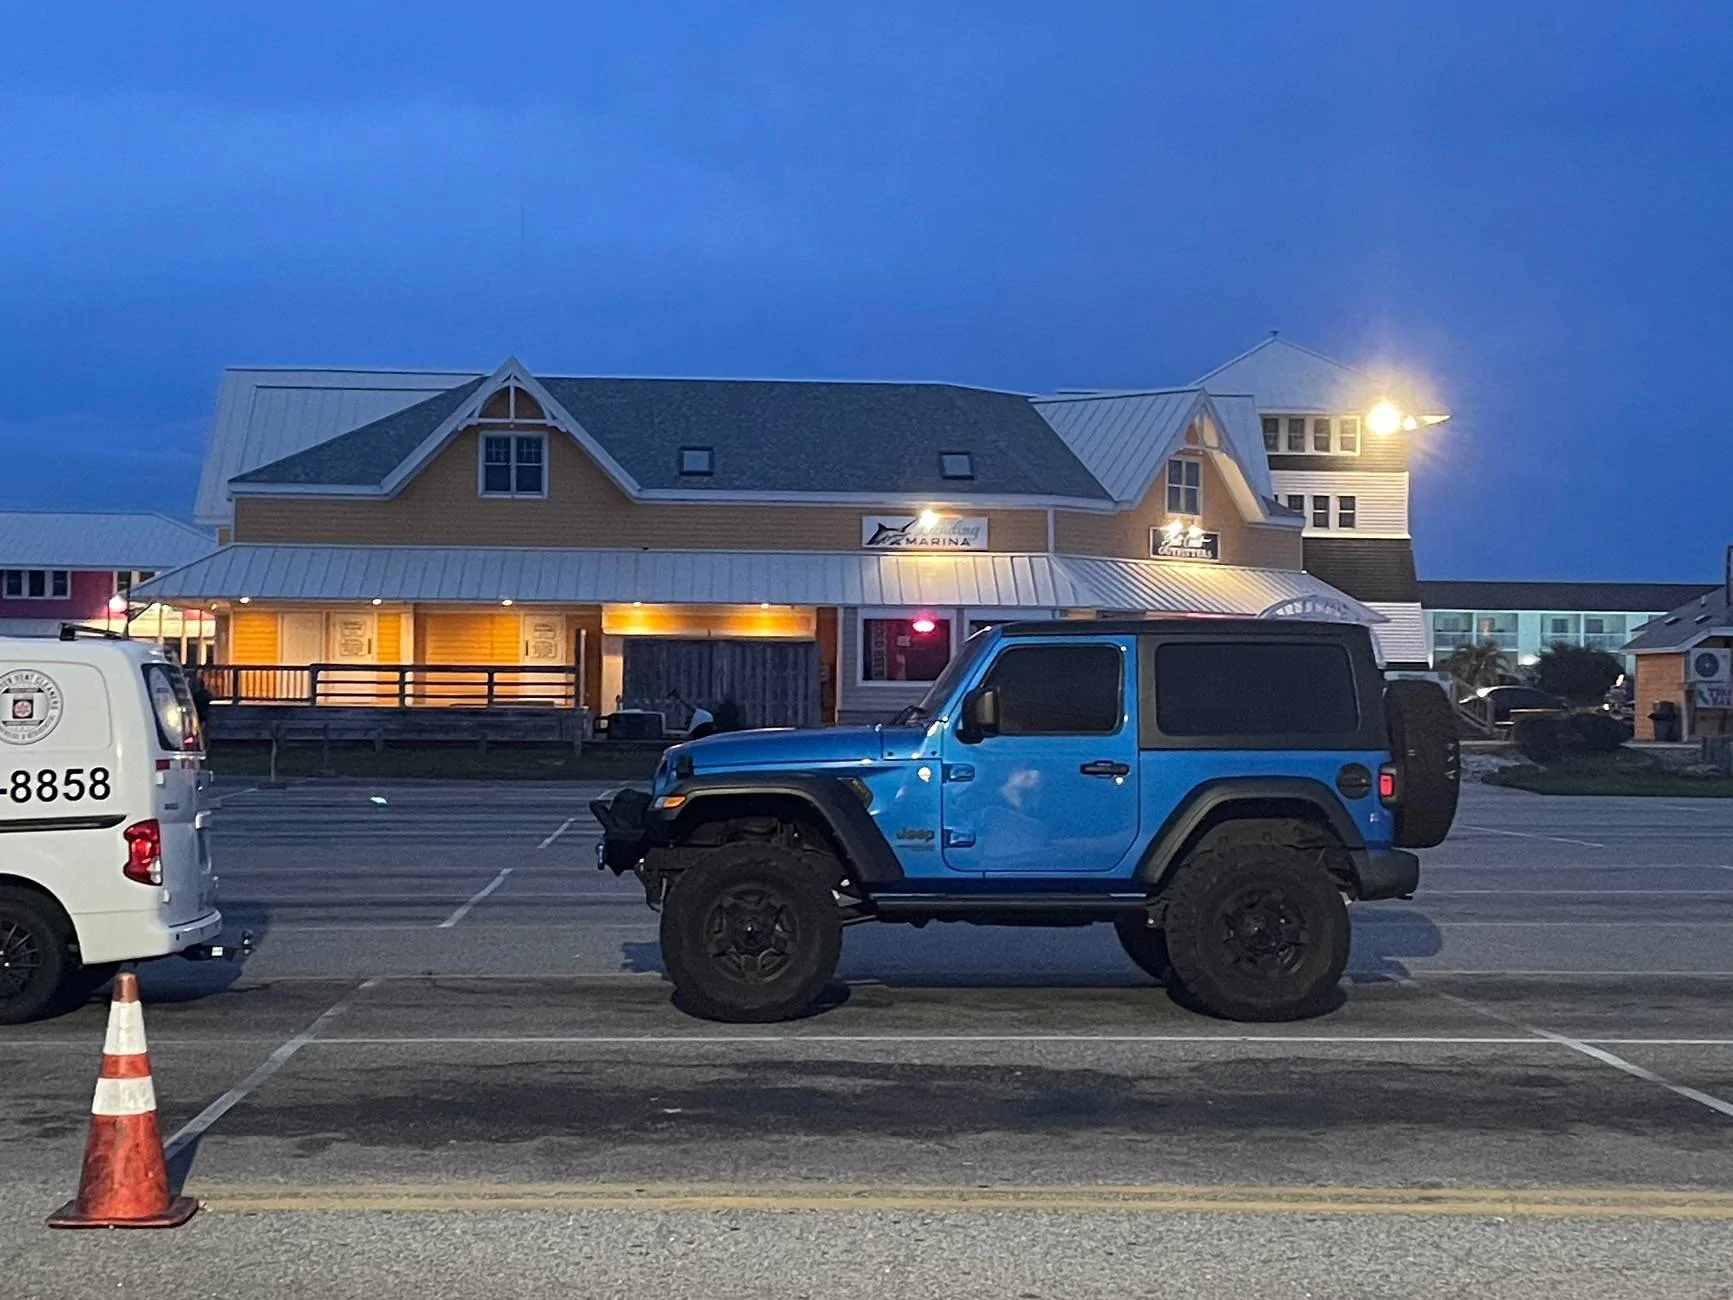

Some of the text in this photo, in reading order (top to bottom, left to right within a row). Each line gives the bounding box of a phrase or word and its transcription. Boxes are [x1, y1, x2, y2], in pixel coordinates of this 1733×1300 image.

[905, 537, 971, 546] MARINA
[0, 766, 111, 803] -8858
[896, 827, 936, 842] Jeep
